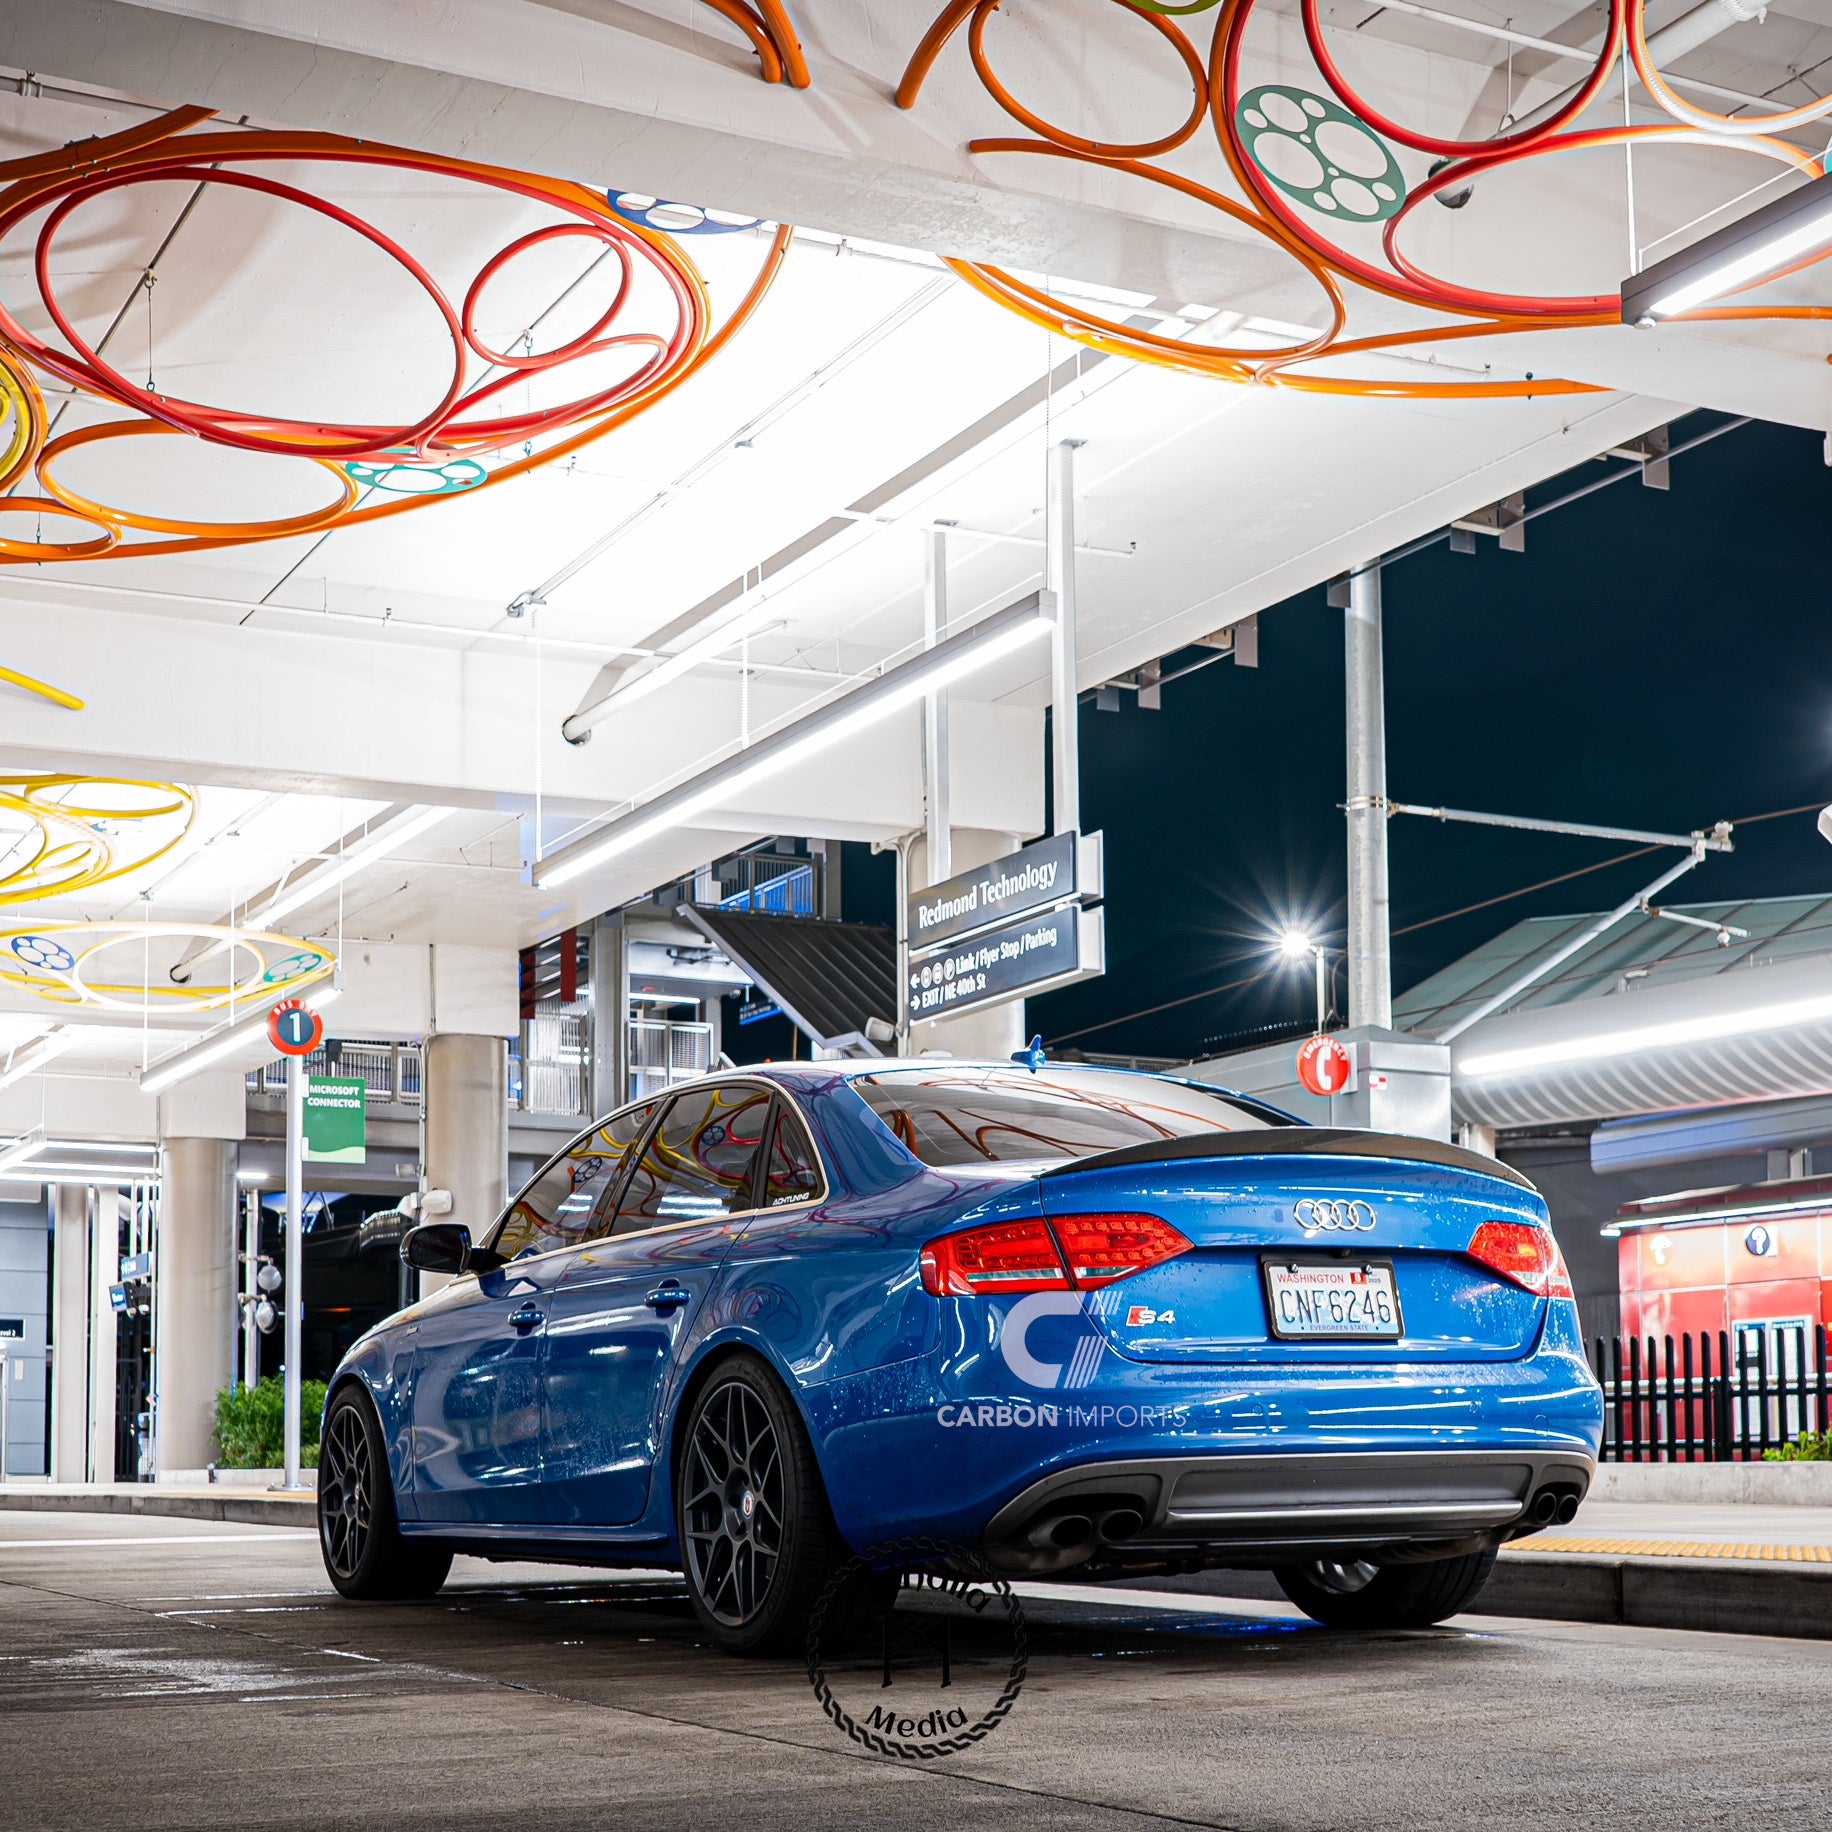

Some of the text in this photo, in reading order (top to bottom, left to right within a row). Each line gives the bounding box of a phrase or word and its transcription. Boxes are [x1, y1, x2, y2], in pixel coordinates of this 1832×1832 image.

[918, 860, 1058, 929] Redmond Technology
[955, 952, 974, 974] Link
[980, 947, 1000, 969] Flyer
[1000, 940, 1020, 960] Stop
[1025, 927, 1057, 951] Parking
[921, 987, 940, 1009] EXIT
[944, 981, 957, 1001] NE
[956, 975, 976, 996] 40th
[976, 972, 987, 991] St
[289, 1011, 301, 1042] 1
[309, 1085, 360, 1096] MICROSOFT
[307, 1097, 361, 1109] CONNECTOR
[772, 1192, 810, 1206] ACHTUNING
[1276, 1273, 1345, 1284] WASHINGTON
[1137, 1309, 1176, 1324] S4
[1280, 1289, 1391, 1324] CNF6246
